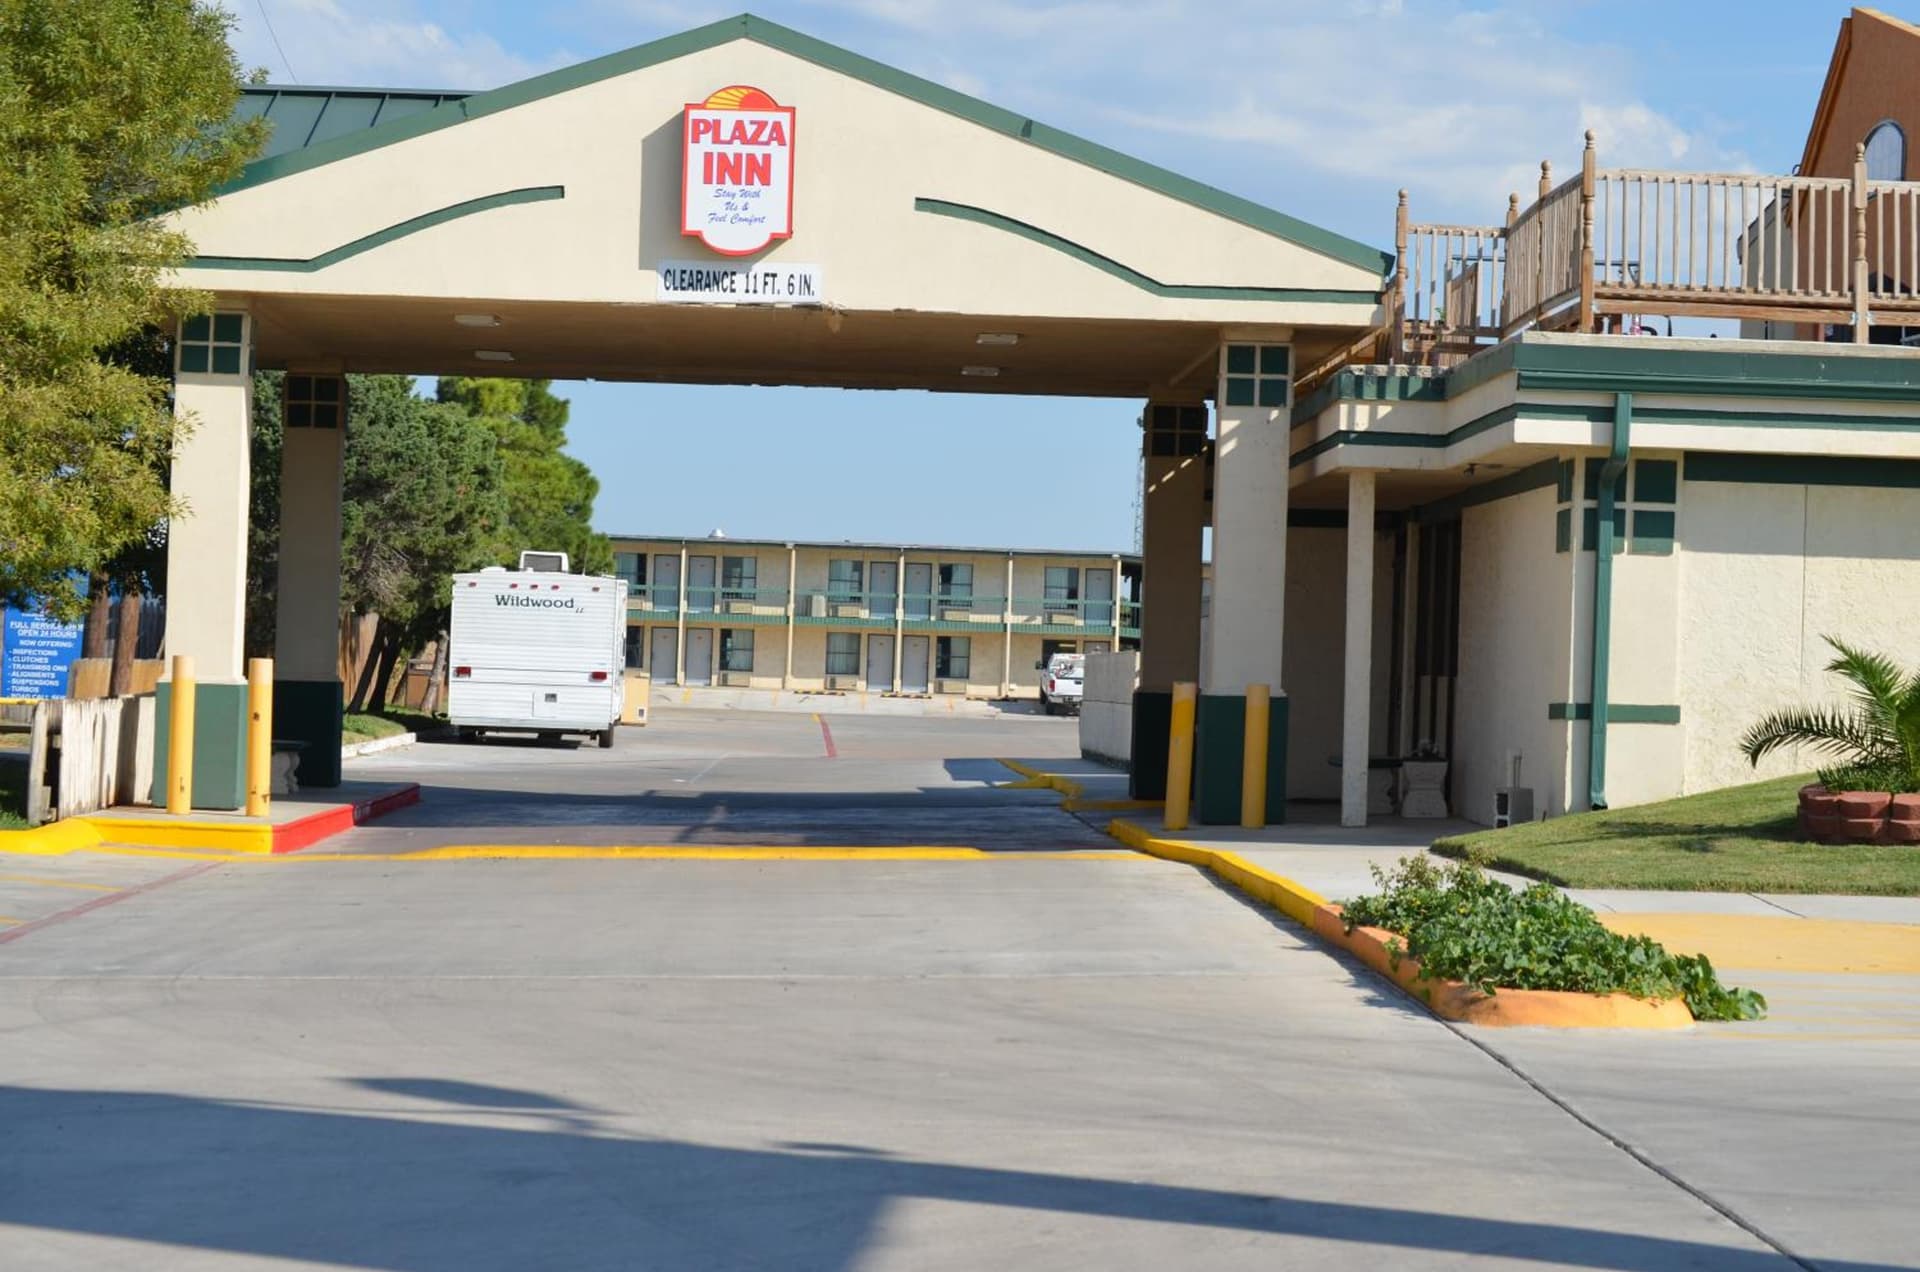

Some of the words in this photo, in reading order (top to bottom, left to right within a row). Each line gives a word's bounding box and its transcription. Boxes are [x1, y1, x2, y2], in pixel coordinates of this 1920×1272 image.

[691, 118, 787, 146] PLAZA
[702, 151, 772, 186] INN
[712, 188, 737, 199] Stay
[739, 189, 761, 198] With
[724, 202, 739, 212] Us
[741, 203, 749, 212] &
[707, 213, 727, 224] Feel
[730, 214, 765, 226] Comfort
[663, 268, 737, 294] CLEARANCE
[744, 273, 758, 295] 11
[762, 273, 781, 296] FT.
[787, 274, 795, 296] 6
[799, 274, 815, 297] IN.
[495, 594, 574, 609] Wildwood
[17, 629, 39, 637] OPEN
[50, 630, 78, 639] HOURS
[12, 656, 49, 664] CLUTCHES
[11, 685, 39, 693] TURBOS
